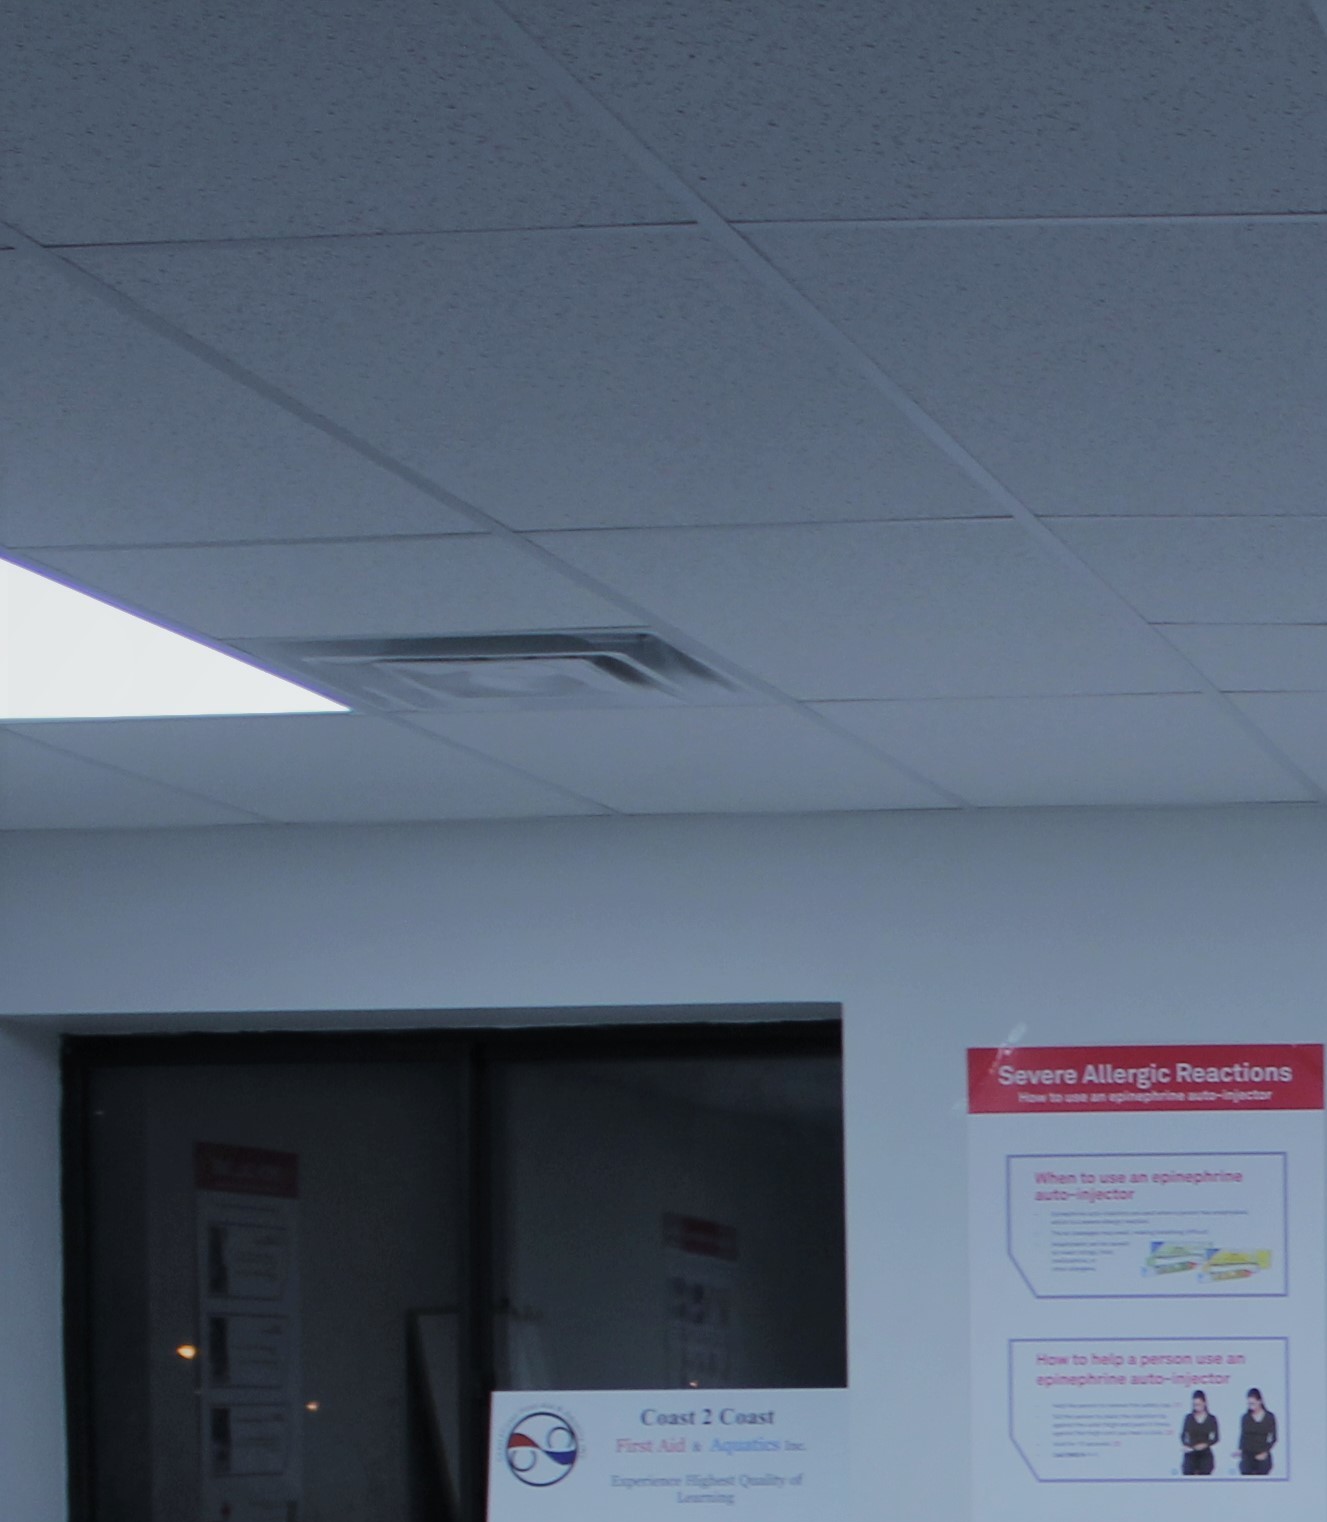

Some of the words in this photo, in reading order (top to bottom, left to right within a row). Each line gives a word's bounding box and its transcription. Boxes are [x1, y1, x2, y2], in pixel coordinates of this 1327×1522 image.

[998, 1065, 1077, 1086] Severe
[1082, 1063, 1171, 1089] Allergic
[1175, 1062, 1293, 1083] Reactions
[1018, 1092, 1046, 1103] How
[1049, 1091, 1063, 1103] to
[1065, 1093, 1087, 1103] use
[1090, 1093, 1106, 1103] an
[1108, 1090, 1185, 1105] epinephrine
[1187, 1089, 1273, 1104] auto-injector
[1034, 1171, 1077, 1184] When
[1080, 1172, 1096, 1184] to
[1099, 1174, 1126, 1184] use
[1129, 1173, 1148, 1183] an
[1151, 1170, 1243, 1186] epinephrine
[1034, 1189, 1135, 1204] auto-injector
[1036, 1353, 1069, 1366] How
[1072, 1354, 1088, 1365] to
[1091, 1352, 1125, 1368] help
[1127, 1356, 1137, 1365] a
[1139, 1355, 1192, 1368] person
[1195, 1355, 1223, 1365] use
[1226, 1354, 1246, 1364] an
[1036, 1373, 1127, 1388] epinephrine
[1130, 1372, 1230, 1388] auto-injector
[640, 1408, 695, 1426] Coast
[701, 1408, 713, 1425] 2
[719, 1408, 775, 1426] Coast
[616, 1438, 652, 1452] First
[657, 1437, 686, 1452] Aid
[711, 1437, 781, 1455] Aquatics
[610, 1475, 682, 1489] Experience
[685, 1474, 735, 1489] Highest
[739, 1473, 785, 1489] Quality
[788, 1472, 804, 1486] of
